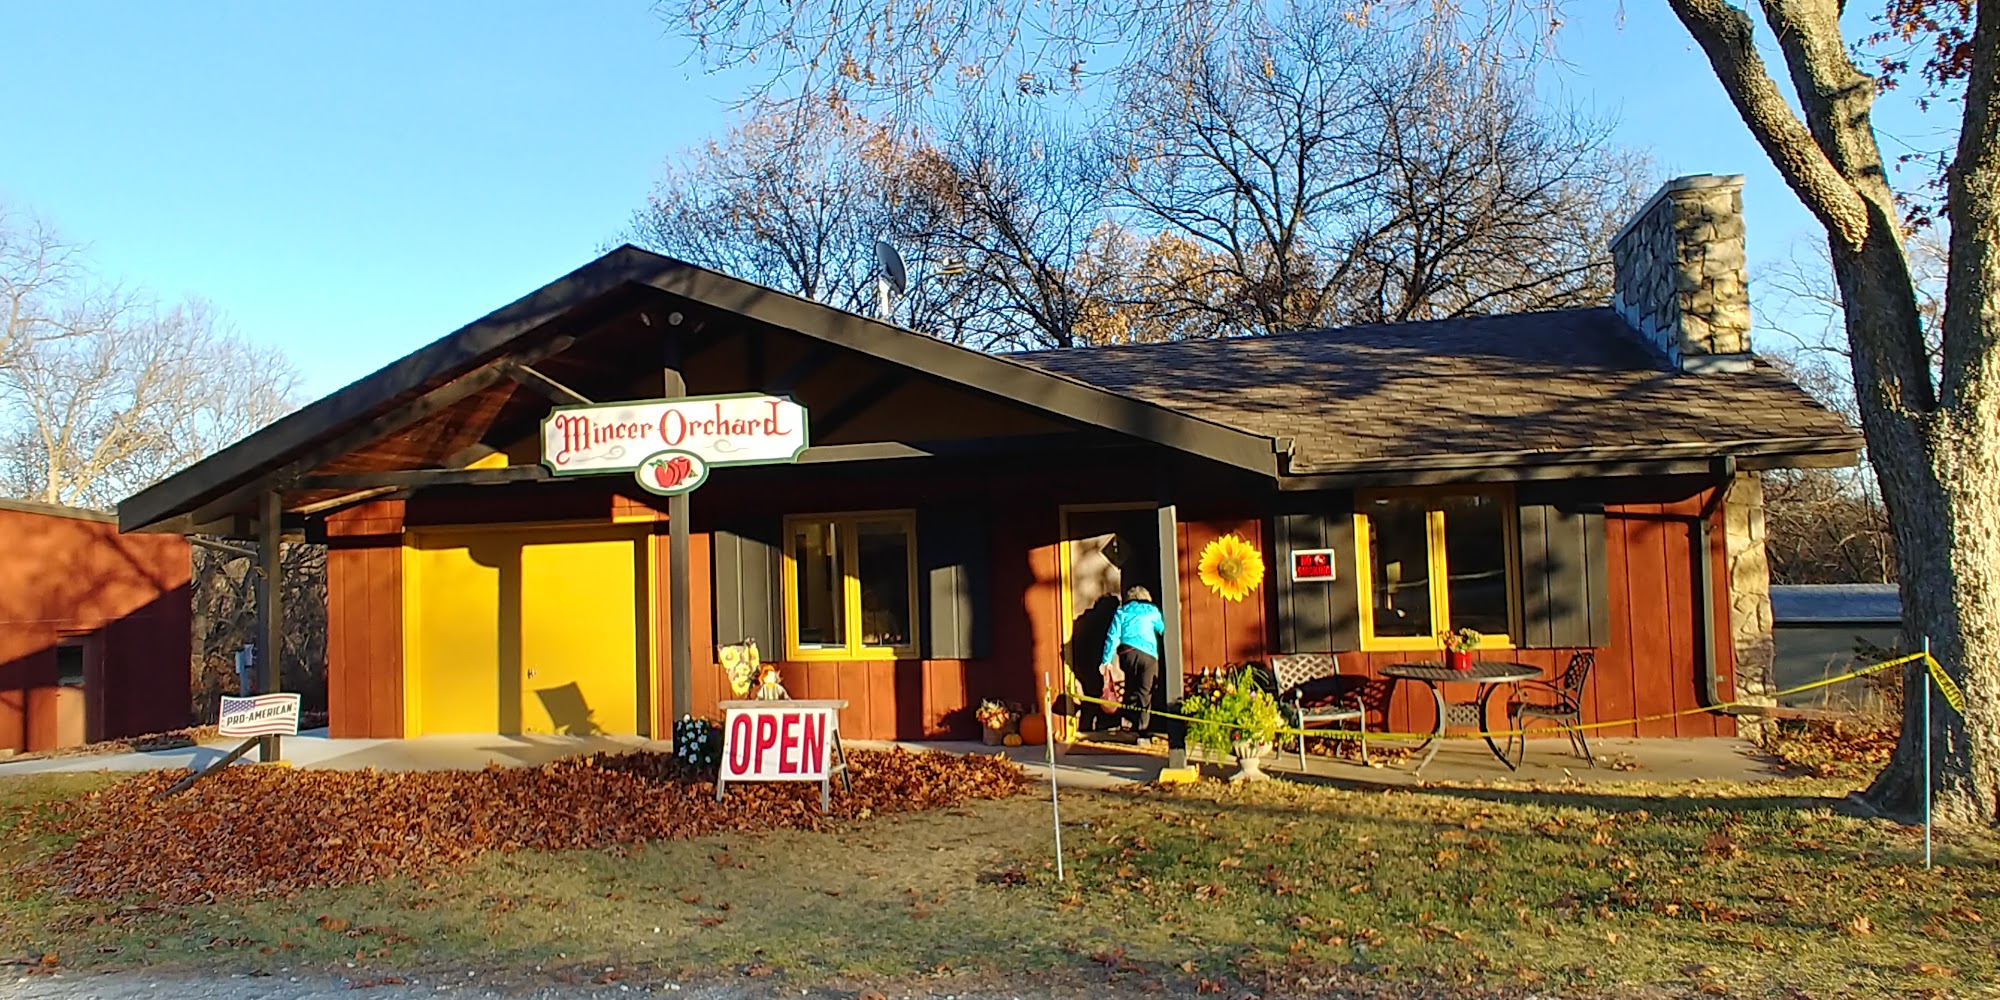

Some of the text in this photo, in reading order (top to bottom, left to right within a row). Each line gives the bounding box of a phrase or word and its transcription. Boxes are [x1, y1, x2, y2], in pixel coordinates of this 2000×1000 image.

[555, 400, 793, 465] Mincer Orchard
[1300, 555, 1312, 566] NO
[227, 703, 293, 726] PRO-AMERICAN
[729, 713, 826, 775] OPEN
